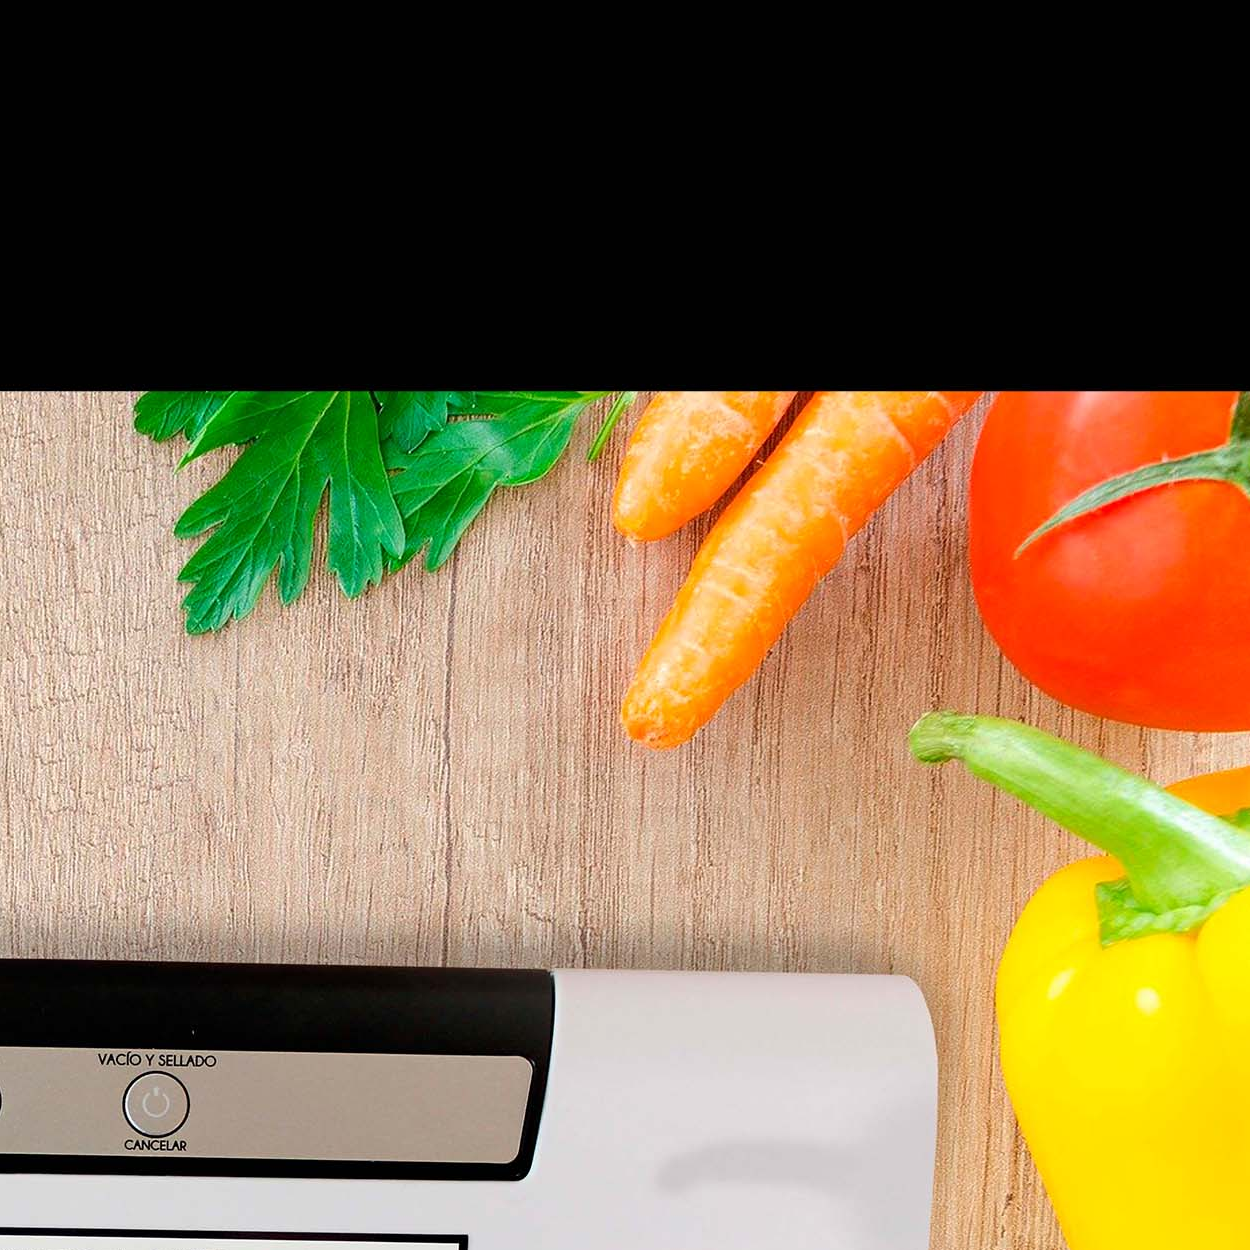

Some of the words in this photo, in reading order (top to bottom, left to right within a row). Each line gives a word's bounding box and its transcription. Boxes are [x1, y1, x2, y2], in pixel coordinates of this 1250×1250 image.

[98, 1051, 142, 1066] VACÍO
[145, 1054, 155, 1066] Y
[158, 1054, 217, 1067] SELLADO
[124, 1140, 187, 1151] CANCELAR
